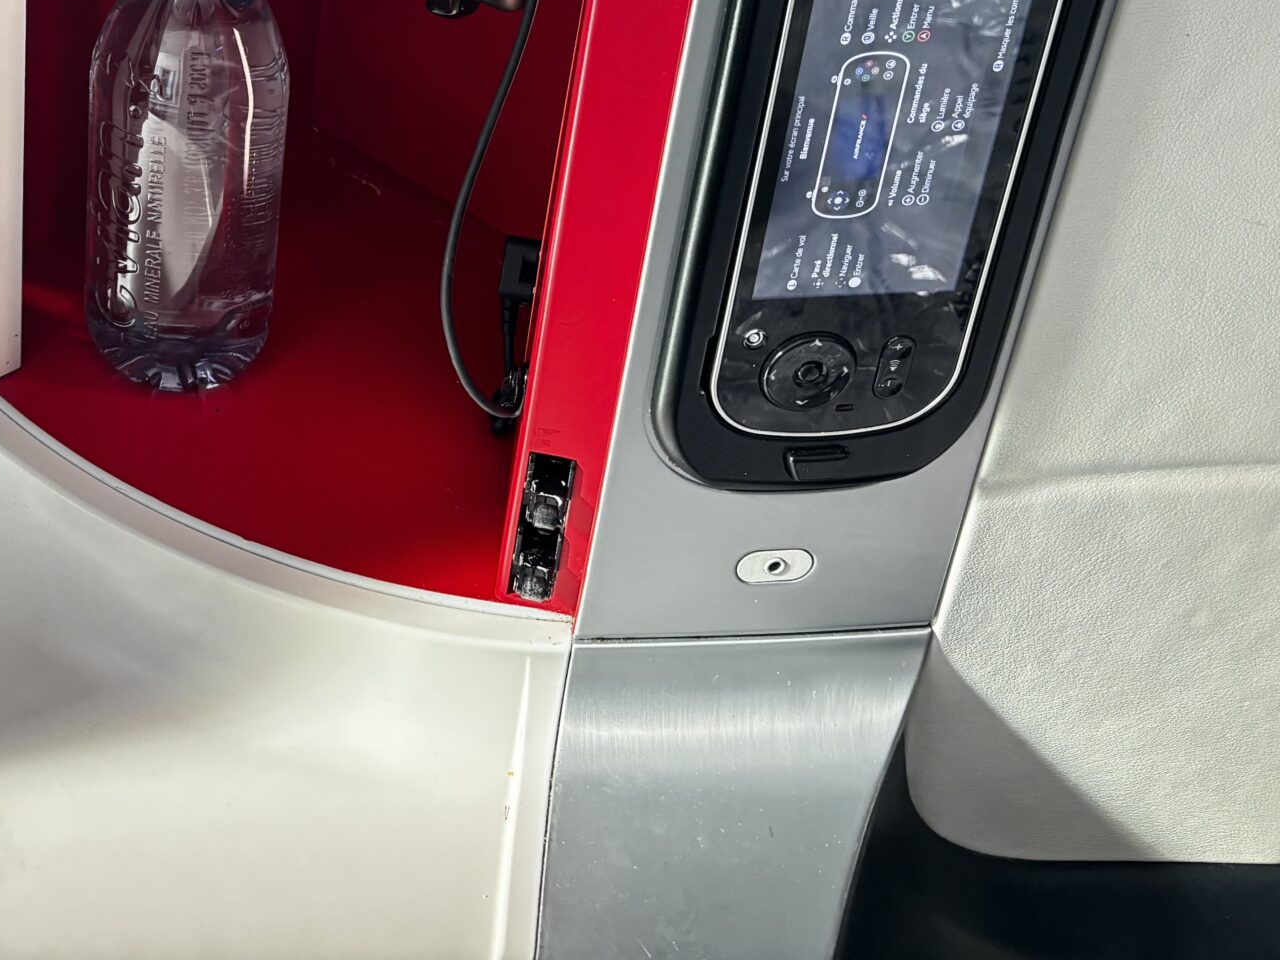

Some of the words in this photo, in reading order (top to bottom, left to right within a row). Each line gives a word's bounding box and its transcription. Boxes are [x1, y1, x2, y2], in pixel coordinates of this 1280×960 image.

[867, 8, 879, 31] Veille
[907, 3, 920, 29] Entrer
[922, 5, 935, 29] Menu
[997, 28, 1012, 59] Masquer
[1005, 15, 1015, 26] les
[907, 76, 925, 123] Commandes
[919, 63, 928, 74] du
[936, 88, 951, 119] Lumière
[952, 95, 964, 118] Appel
[963, 83, 979, 119] équipage
[794, 96, 806, 127] principal
[918, 102, 930, 123] siège
[788, 127, 798, 148] écran
[799, 118, 815, 159] Bienvenue
[786, 149, 795, 169] votre
[907, 151, 924, 193] Augmenter
[146, 135, 167, 223] NATURELLE
[781, 170, 789, 182] Sur
[888, 170, 902, 198] Volume
[921, 159, 936, 193] Diminuer
[795, 248, 803, 257] de
[798, 235, 806, 246] vol
[144, 230, 163, 304] MINERALE
[790, 258, 801, 279] Carte
[811, 259, 822, 278] Pavé
[822, 233, 839, 278] directionnel
[839, 244, 853, 277] Naviguer
[853, 253, 864, 276] Entrer
